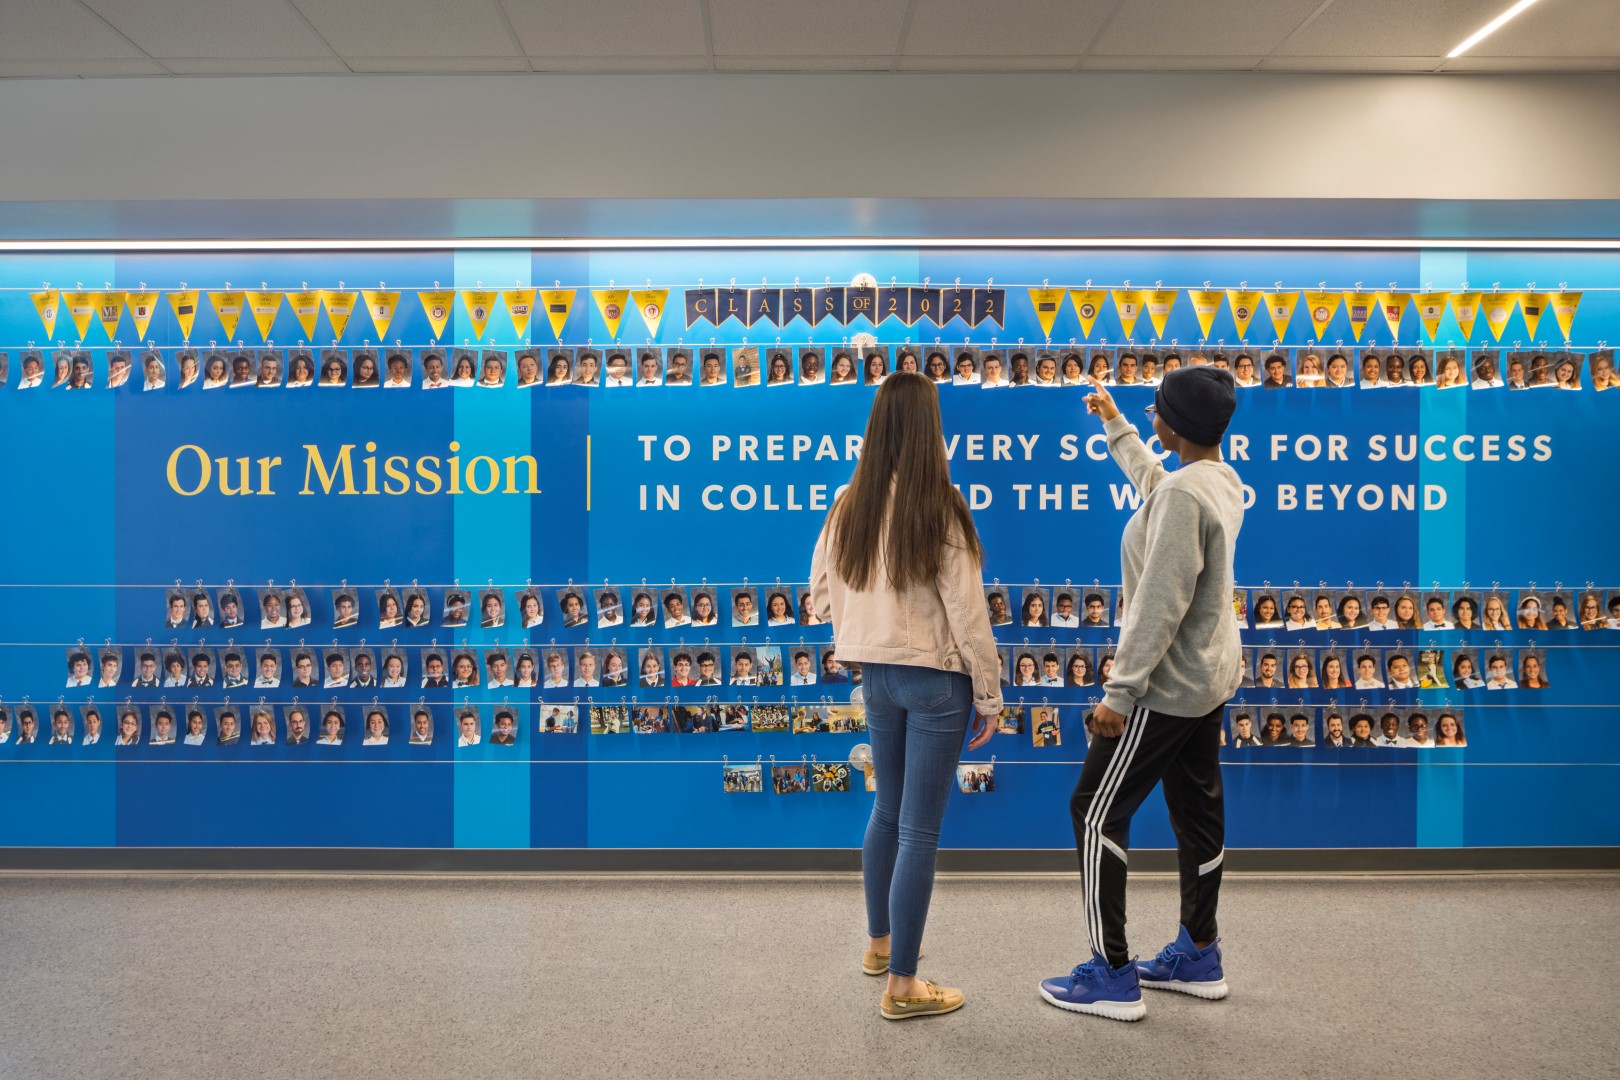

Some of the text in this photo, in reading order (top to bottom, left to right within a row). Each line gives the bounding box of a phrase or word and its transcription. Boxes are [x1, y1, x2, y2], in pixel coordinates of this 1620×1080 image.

[695, 297, 994, 313] CLASS OF 2022
[637, 434, 691, 461] TO
[713, 434, 865, 461] PREPAR
[942, 434, 1040, 461] VERY
[1270, 434, 1349, 461] FOR
[1368, 434, 1552, 461] SUCCESS
[166, 441, 541, 496] Our Mission
[639, 484, 680, 510] IN
[701, 484, 849, 510] COLLE
[1012, 484, 1089, 510] THE
[1277, 484, 1447, 511] BEYOND
